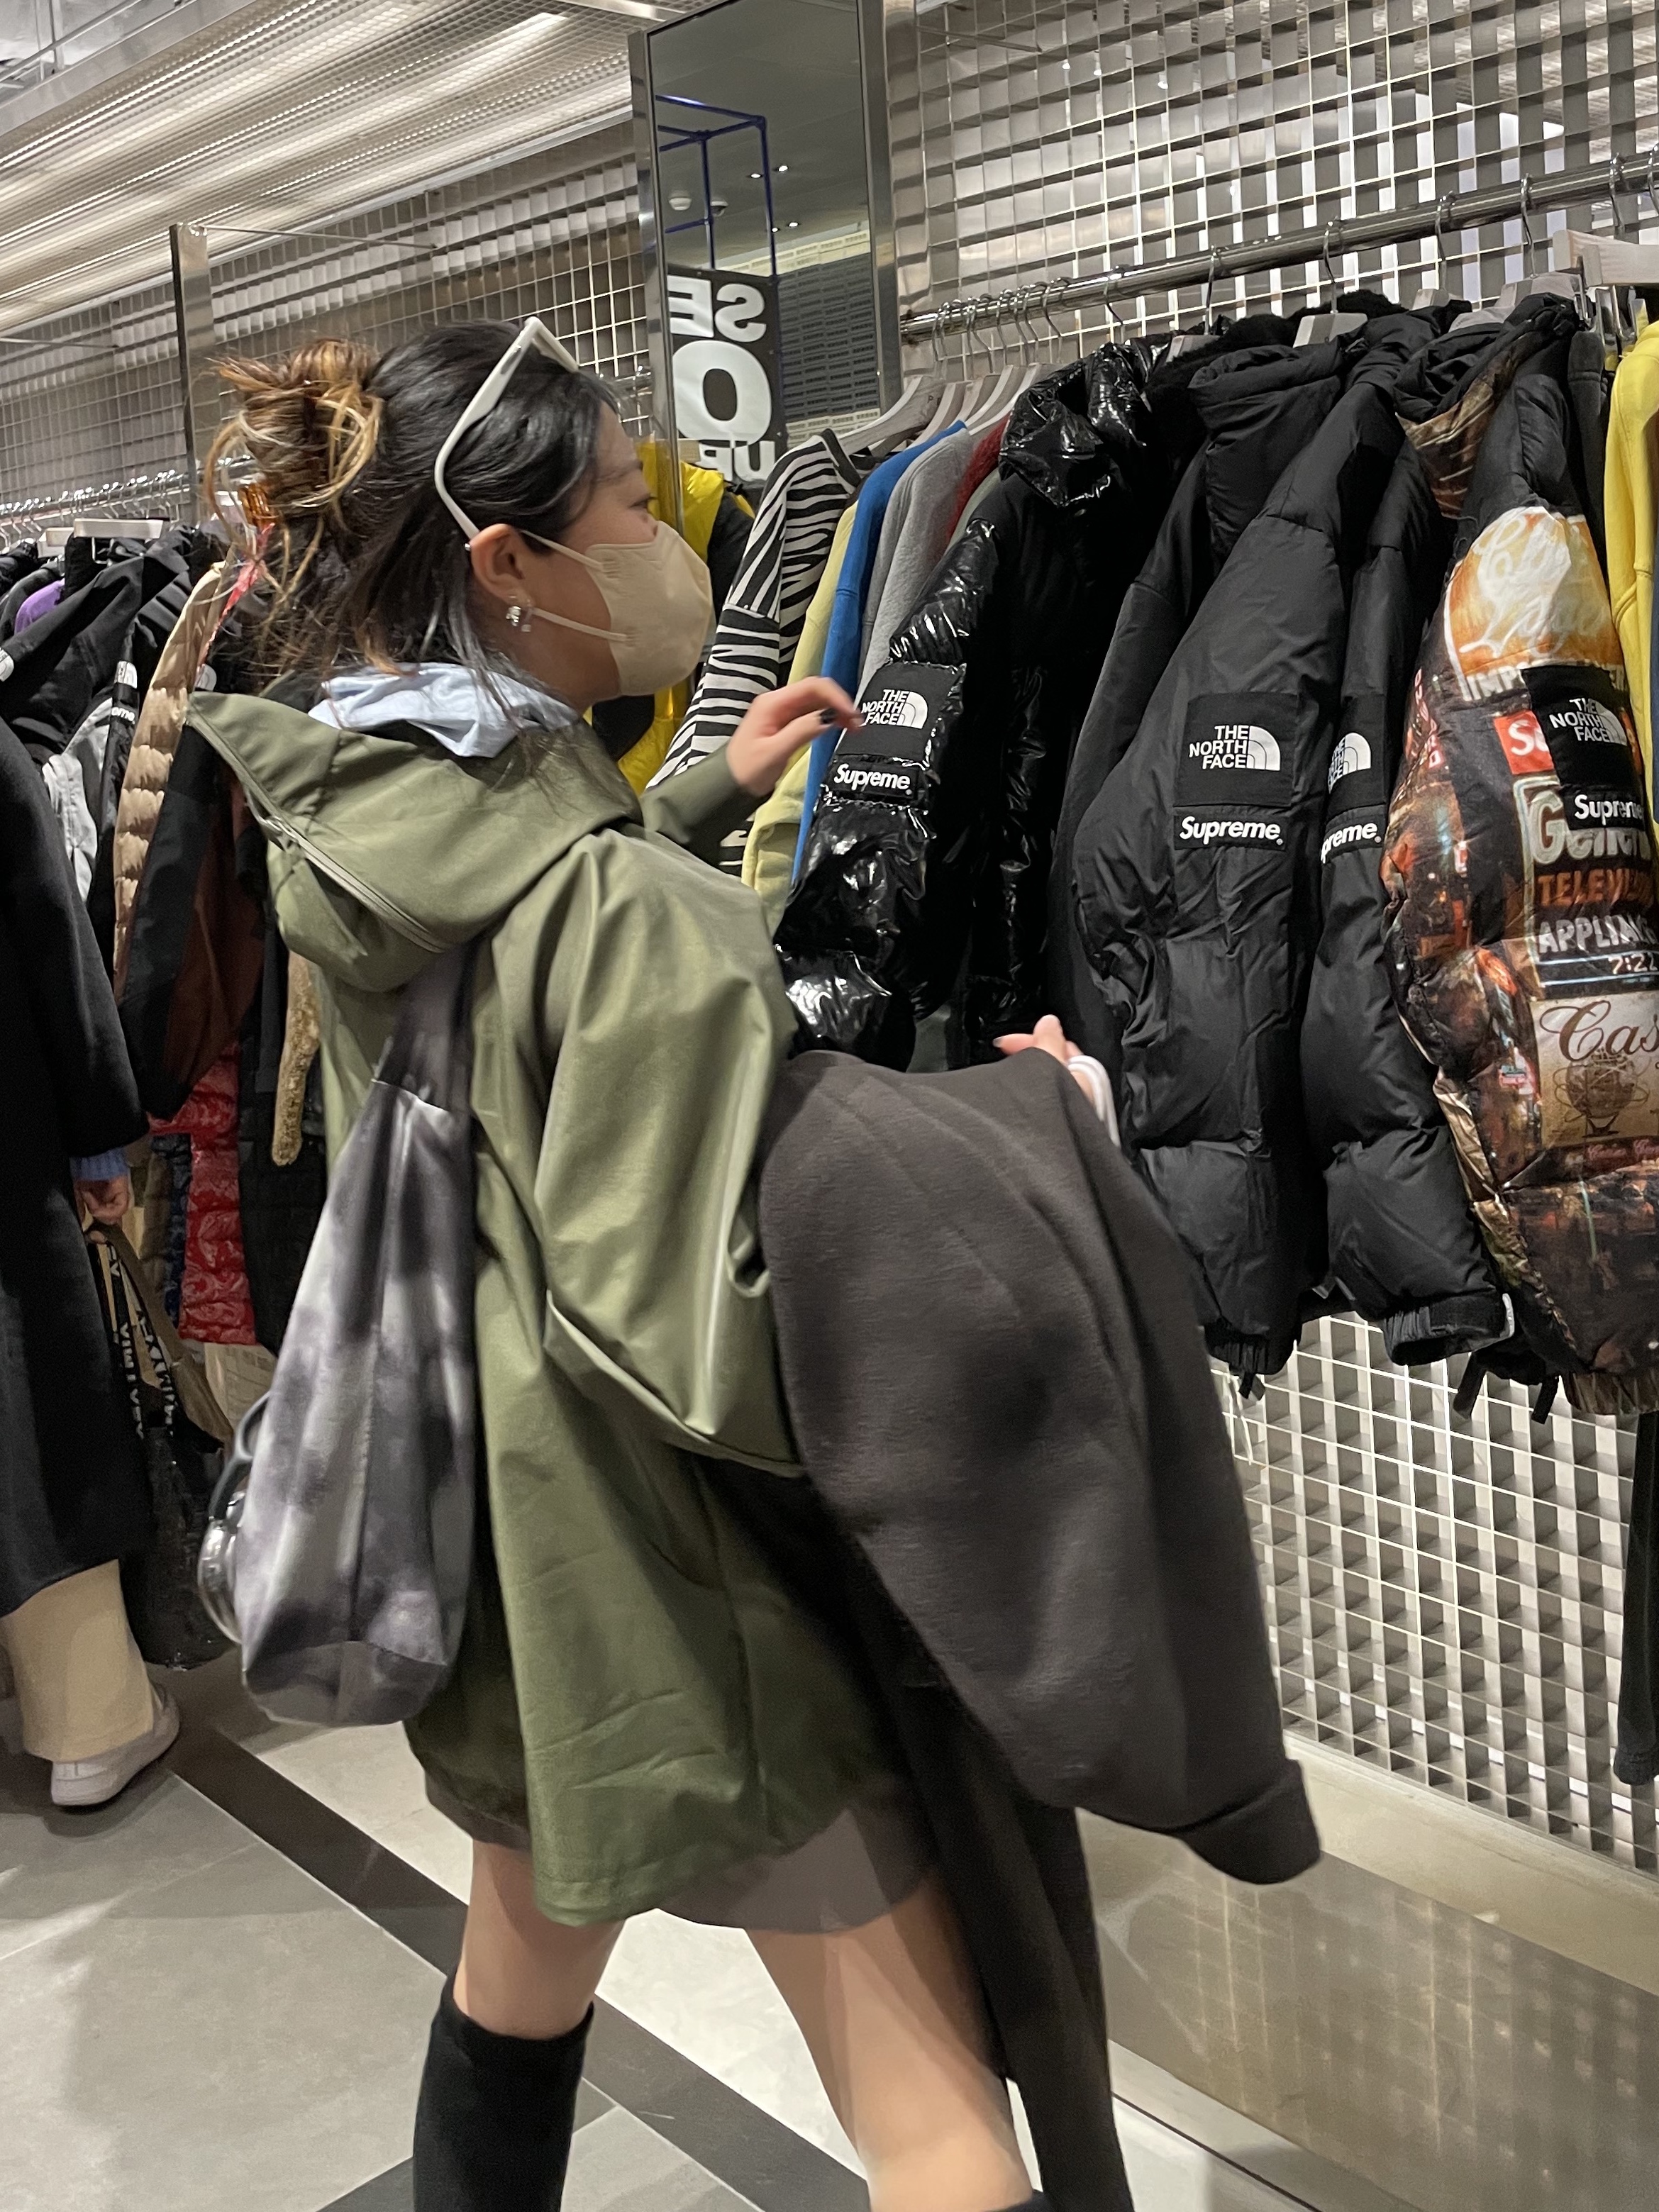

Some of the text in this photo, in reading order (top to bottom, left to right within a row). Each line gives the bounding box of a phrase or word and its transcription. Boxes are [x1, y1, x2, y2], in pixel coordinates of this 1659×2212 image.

[882, 689, 909, 702] THE
[861, 701, 904, 713] NORTH
[1569, 698, 1597, 713] THE
[866, 712, 900, 726] FACE
[1549, 712, 1603, 728] NORTH
[1214, 725, 1249, 740] THE
[1574, 726, 1609, 743] FACE
[1189, 740, 1247, 757] NORTH
[1202, 754, 1247, 769] FACE
[833, 763, 911, 791] Supreme
[1179, 816, 1281, 845] Supreme
